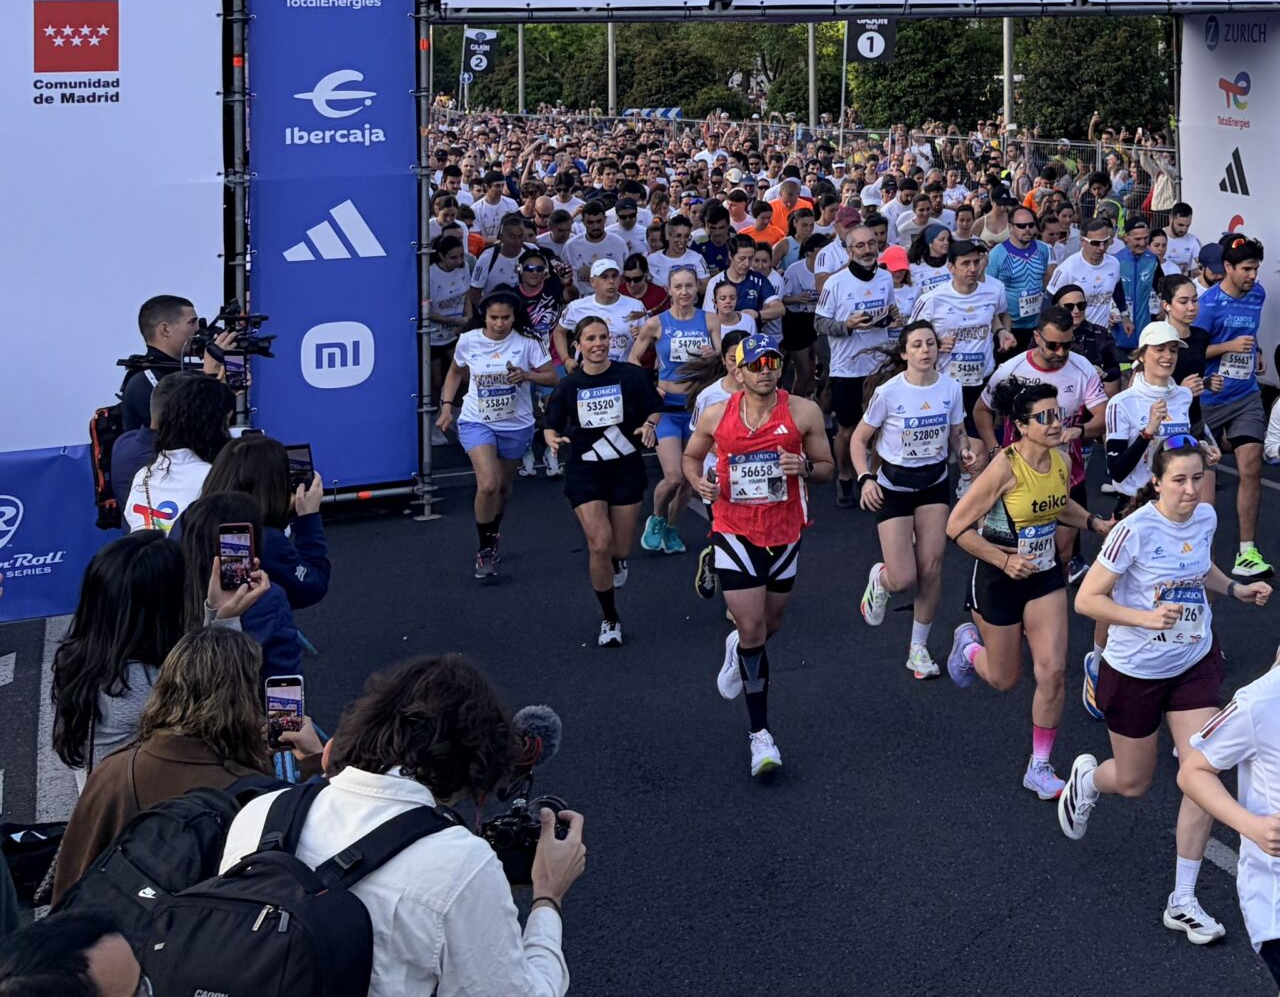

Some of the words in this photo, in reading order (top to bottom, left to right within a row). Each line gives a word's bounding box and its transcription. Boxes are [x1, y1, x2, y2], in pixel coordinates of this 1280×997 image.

[1224, 23, 1267, 44] ZURICH
[867, 36, 874, 53] 1
[475, 57, 483, 68] 2
[33, 78, 120, 90] Comunidad
[33, 92, 54, 105] de
[60, 91, 120, 104] Madrid
[1217, 115, 1251, 130] TotalEnergies
[285, 123, 386, 146] Ibercaja
[591, 387, 617, 397] ZURICH
[586, 399, 614, 412] 53520
[912, 428, 940, 442] 52809
[741, 464, 773, 478] 56658
[13, 551, 64, 568] Roll
[6, 566, 52, 578] SERIES
